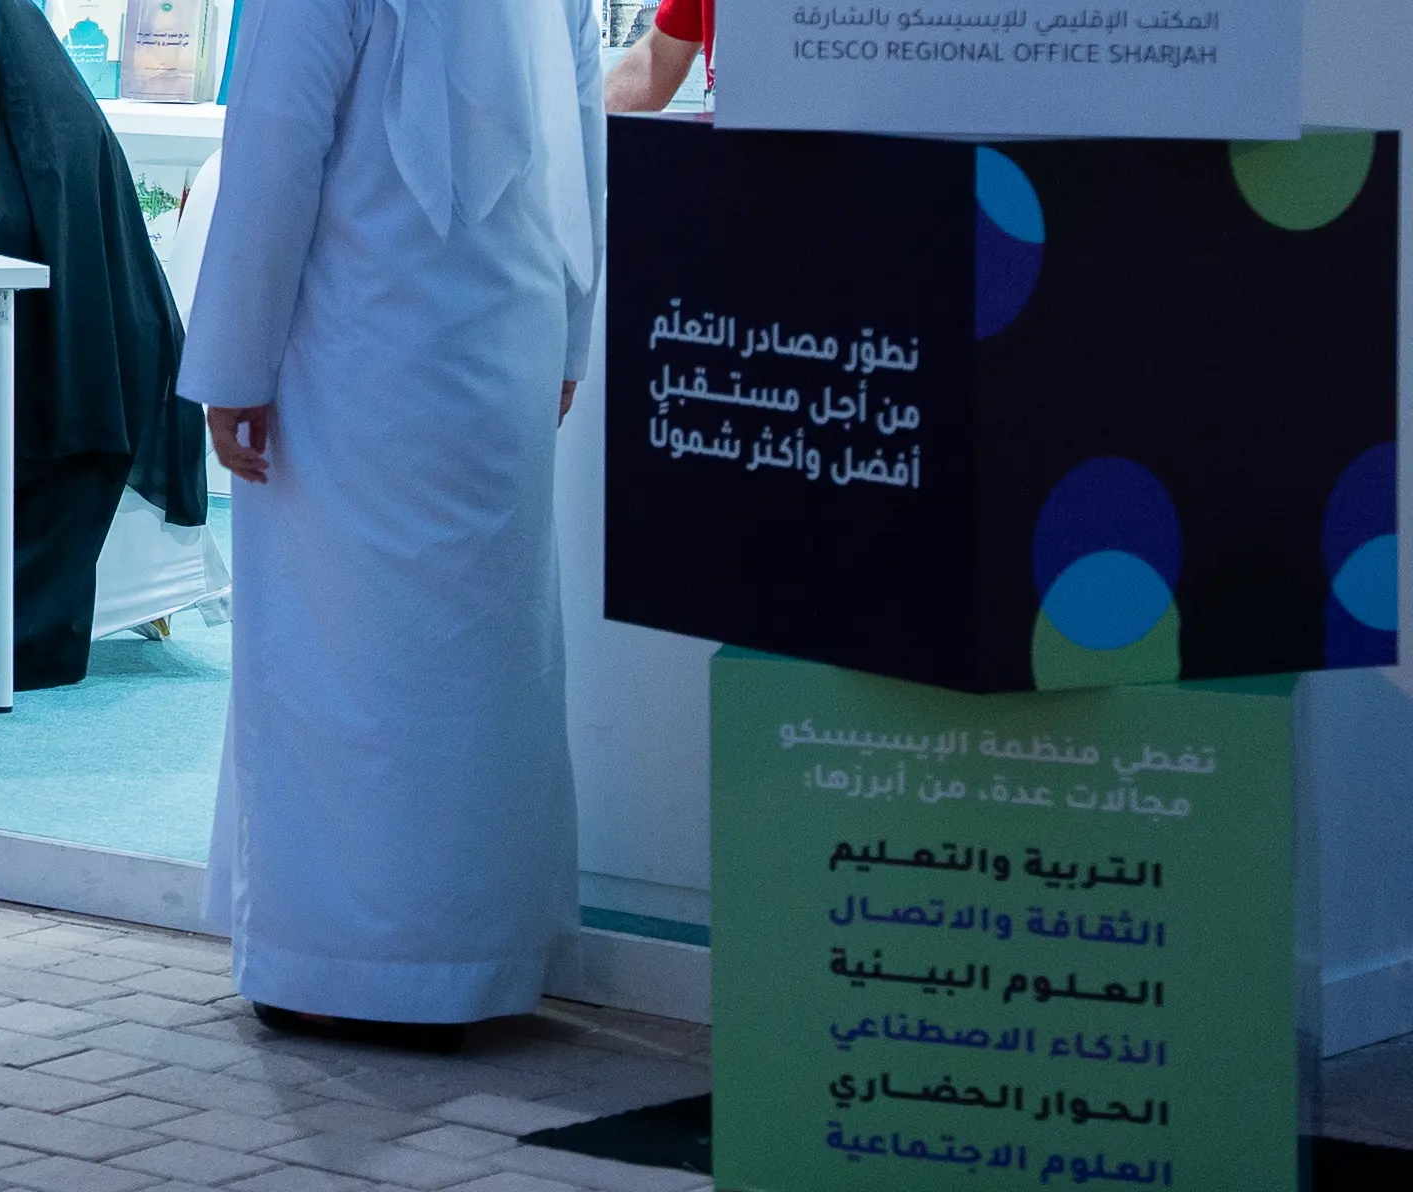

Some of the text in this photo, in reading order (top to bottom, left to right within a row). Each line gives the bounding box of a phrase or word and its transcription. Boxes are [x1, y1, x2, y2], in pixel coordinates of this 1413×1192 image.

[793, 5, 1220, 36] المكتب الإقليمي للإيسيسكو بالشارقة
[794, 39, 1217, 68] ICESCO REGIONAL OFFICE SHARJAH
[739, 321, 839, 361] مصادر
[808, 378, 869, 430] أجل
[875, 395, 921, 435] من
[744, 424, 822, 481] وأكثر
[829, 444, 922, 490] أفضل
[777, 718, 1219, 778] تغطي منظمة الإيسيسكو
[803, 761, 907, 800] أبرزها:
[916, 773, 967, 804] من
[1066, 785, 1193, 822] مجالات
[828, 836, 1164, 891] التربية والتعليم
[828, 893, 1167, 949] الثقافة والاتصال
[829, 945, 1166, 1008] العلوم البينية
[829, 1011, 1168, 1067] الذكاء الاصطناعي
[828, 1070, 1170, 1127] الحوار الحضاري
[824, 1118, 1174, 1188] العلوم الاجتماعية
